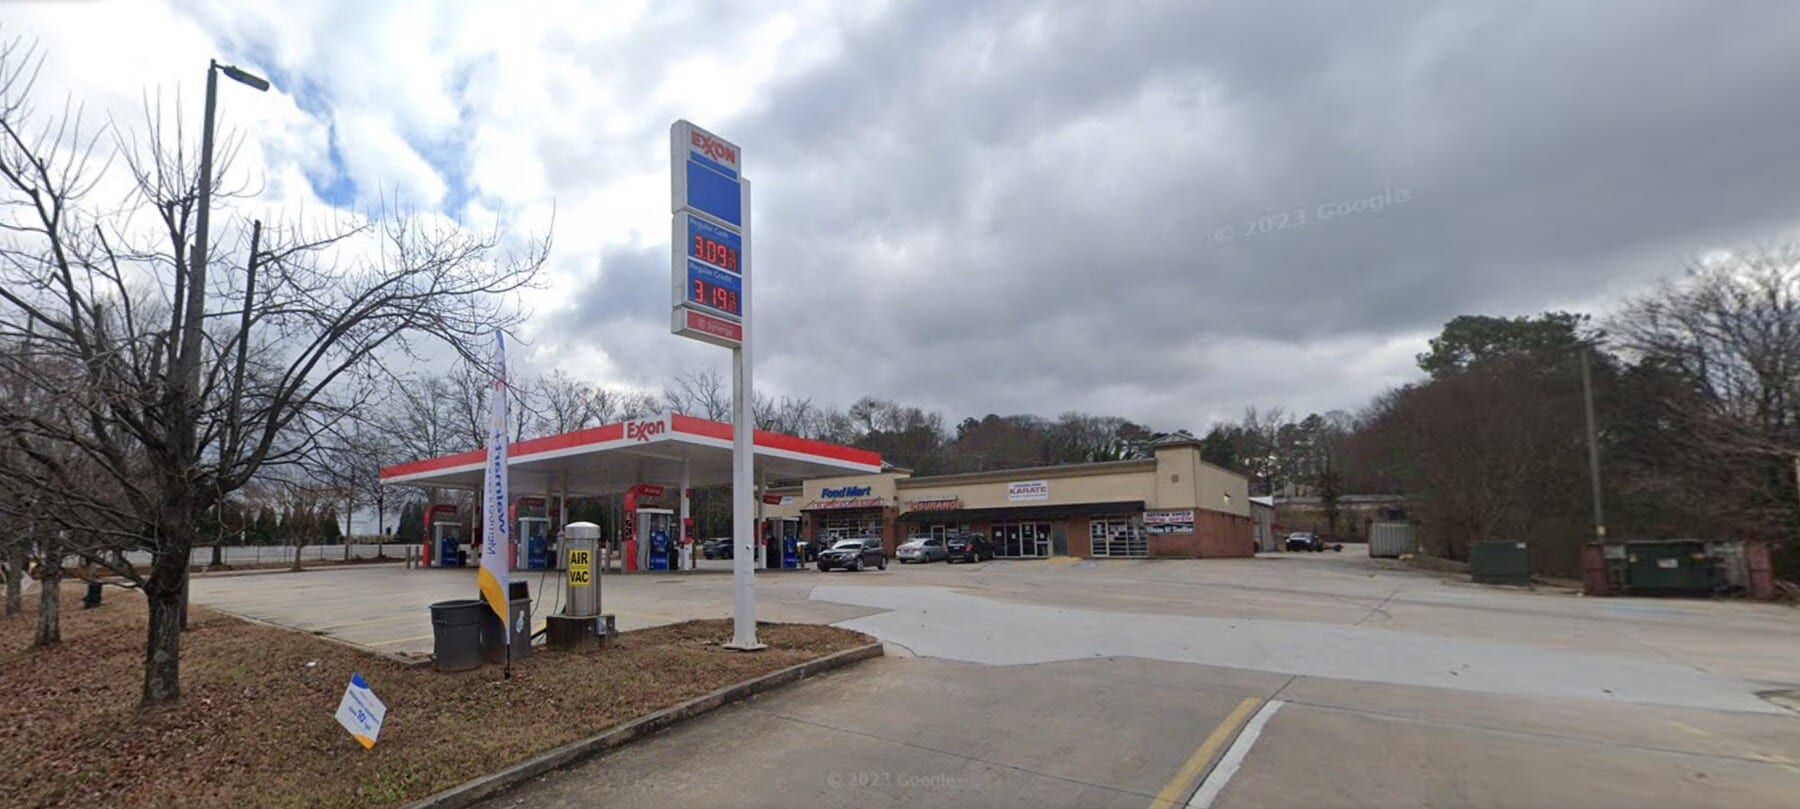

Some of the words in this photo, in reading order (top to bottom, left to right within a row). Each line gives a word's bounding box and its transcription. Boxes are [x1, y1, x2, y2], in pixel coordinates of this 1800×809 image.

[694, 235, 727, 267] 3.09
[626, 418, 666, 442] Exxon
[821, 487, 846, 498] Food
[847, 485, 872, 497] Mart
[1009, 486, 1047, 494] KARATE
[570, 551, 588, 565] AIR
[569, 570, 589, 583] VAC
